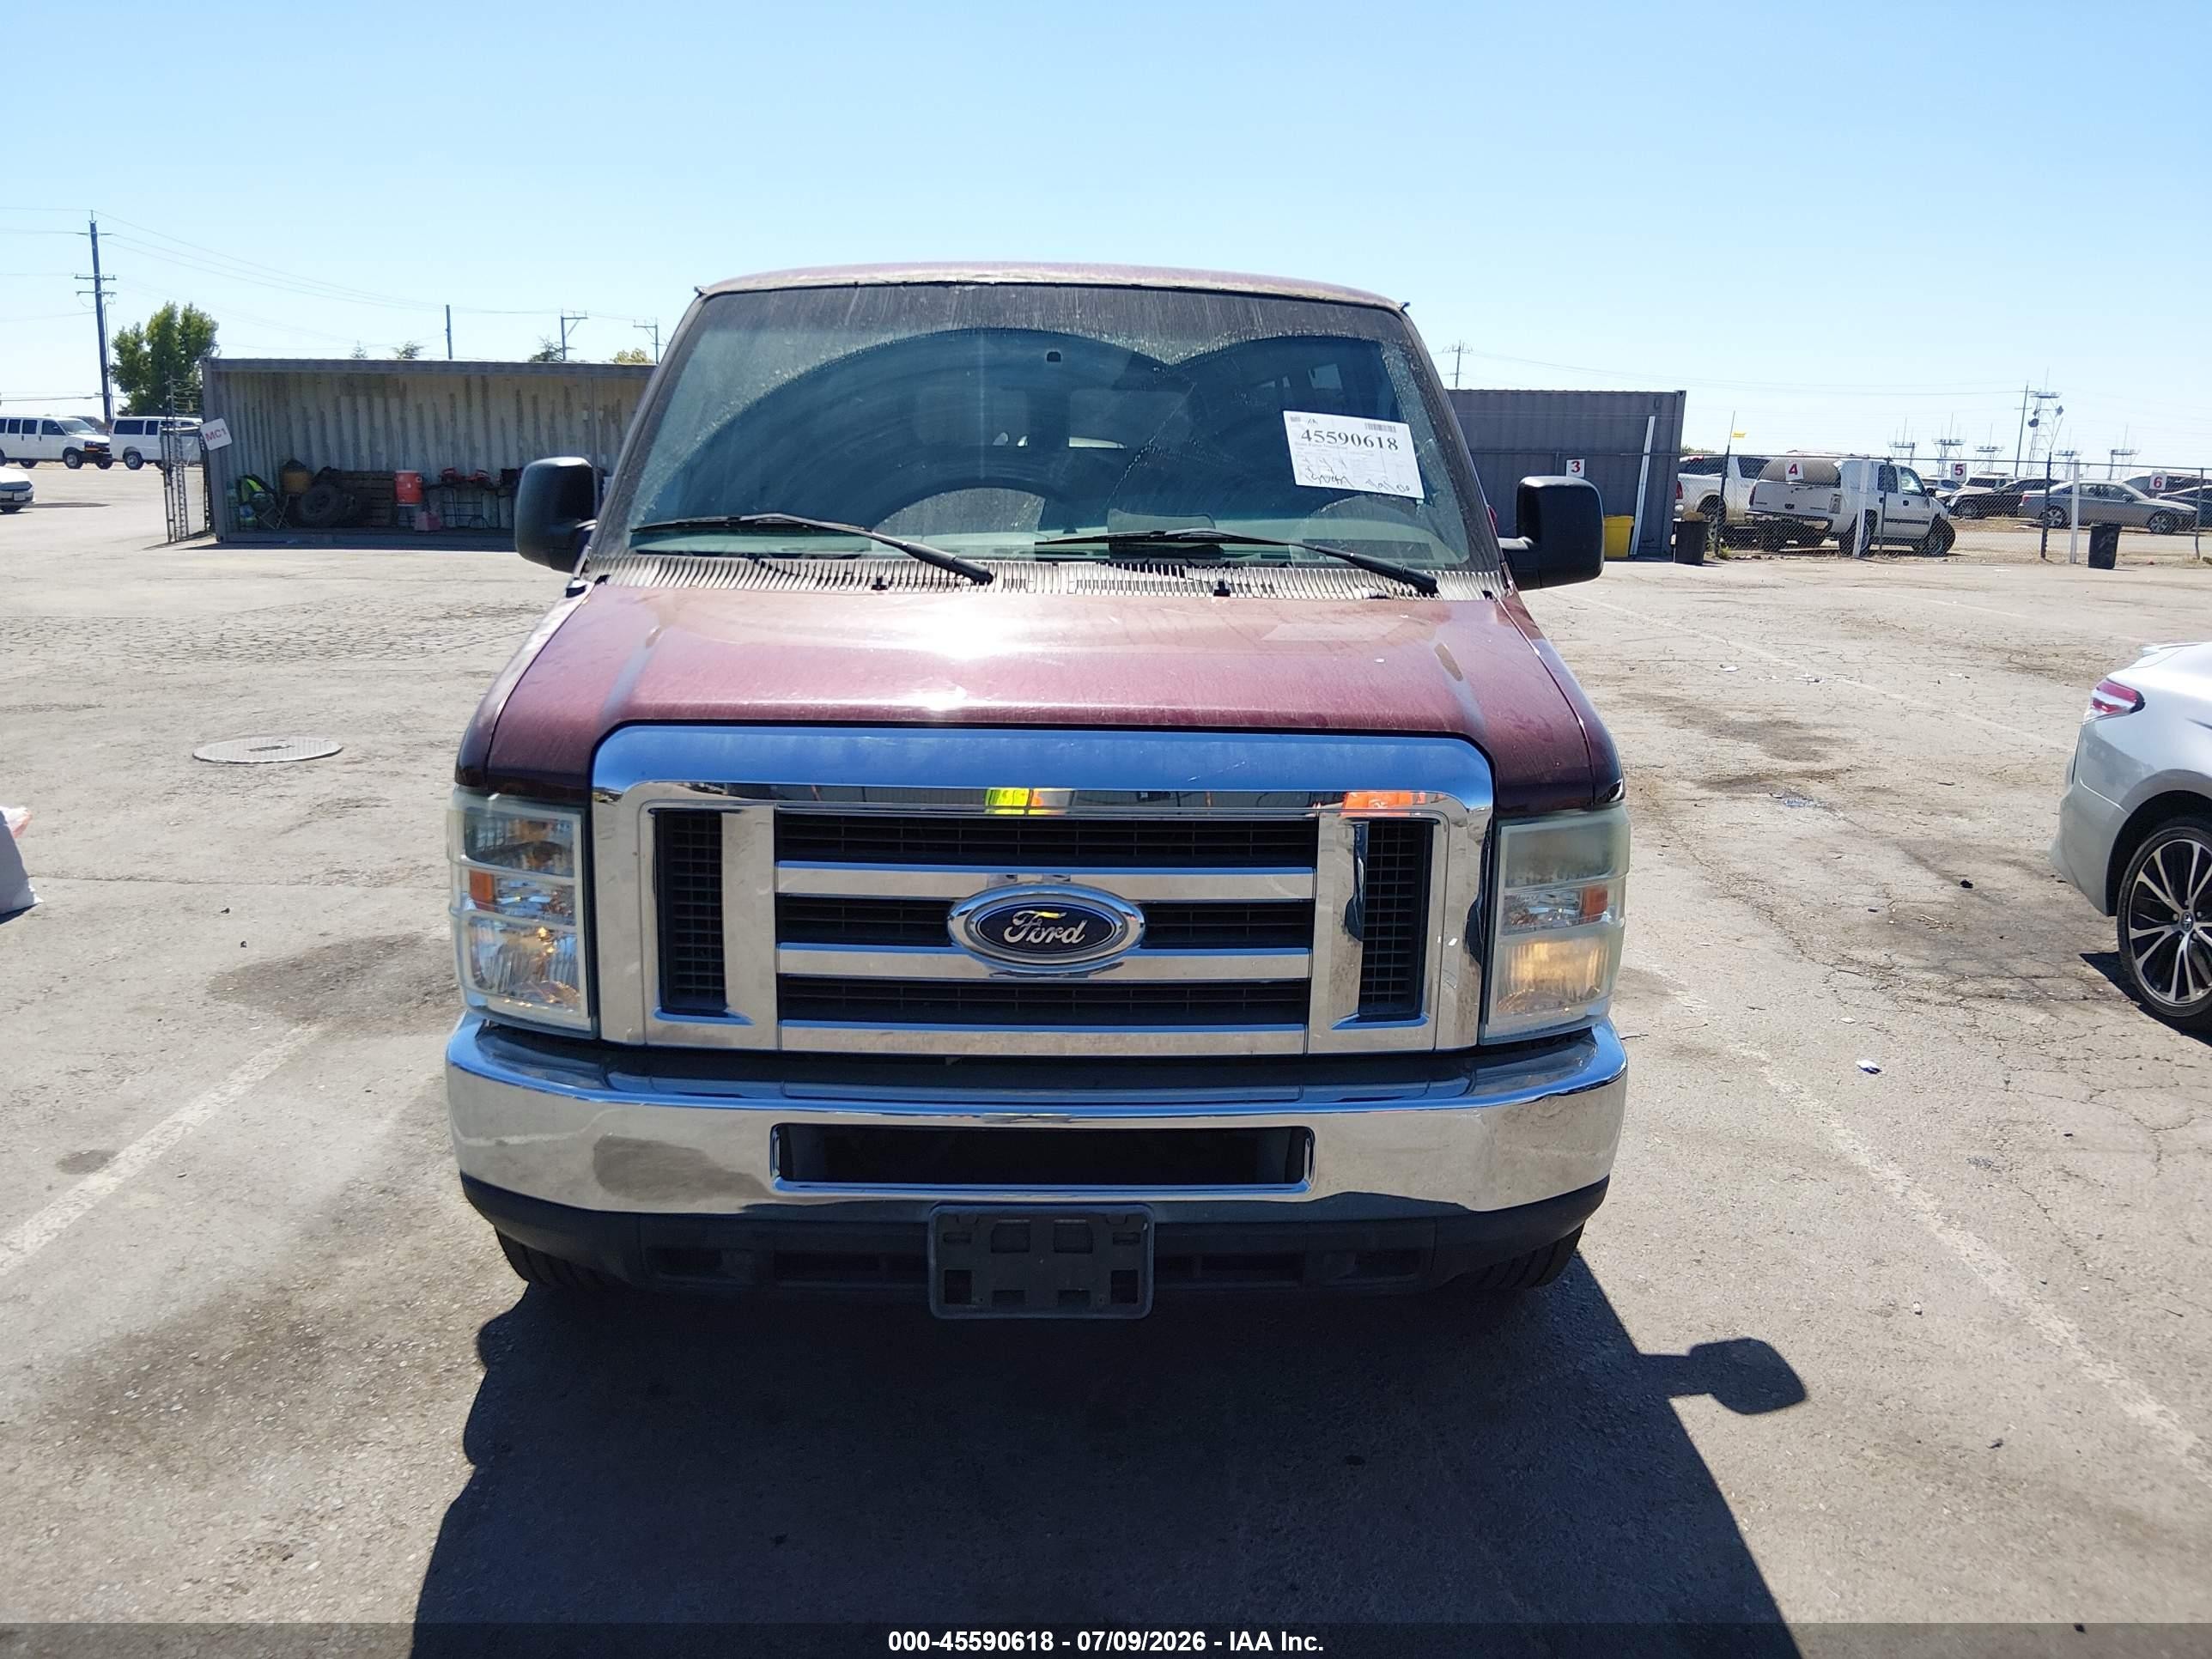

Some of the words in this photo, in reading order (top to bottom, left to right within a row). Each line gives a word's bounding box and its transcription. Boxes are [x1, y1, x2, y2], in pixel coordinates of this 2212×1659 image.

[205, 428, 227, 441] MC1
[1301, 428, 1399, 451] 45590618
[1571, 460, 1582, 474] 3
[1789, 463, 1799, 476] 4
[1955, 464, 1965, 477] 5
[2154, 477, 2164, 490] 6
[1003, 909, 1088, 944] Ford
